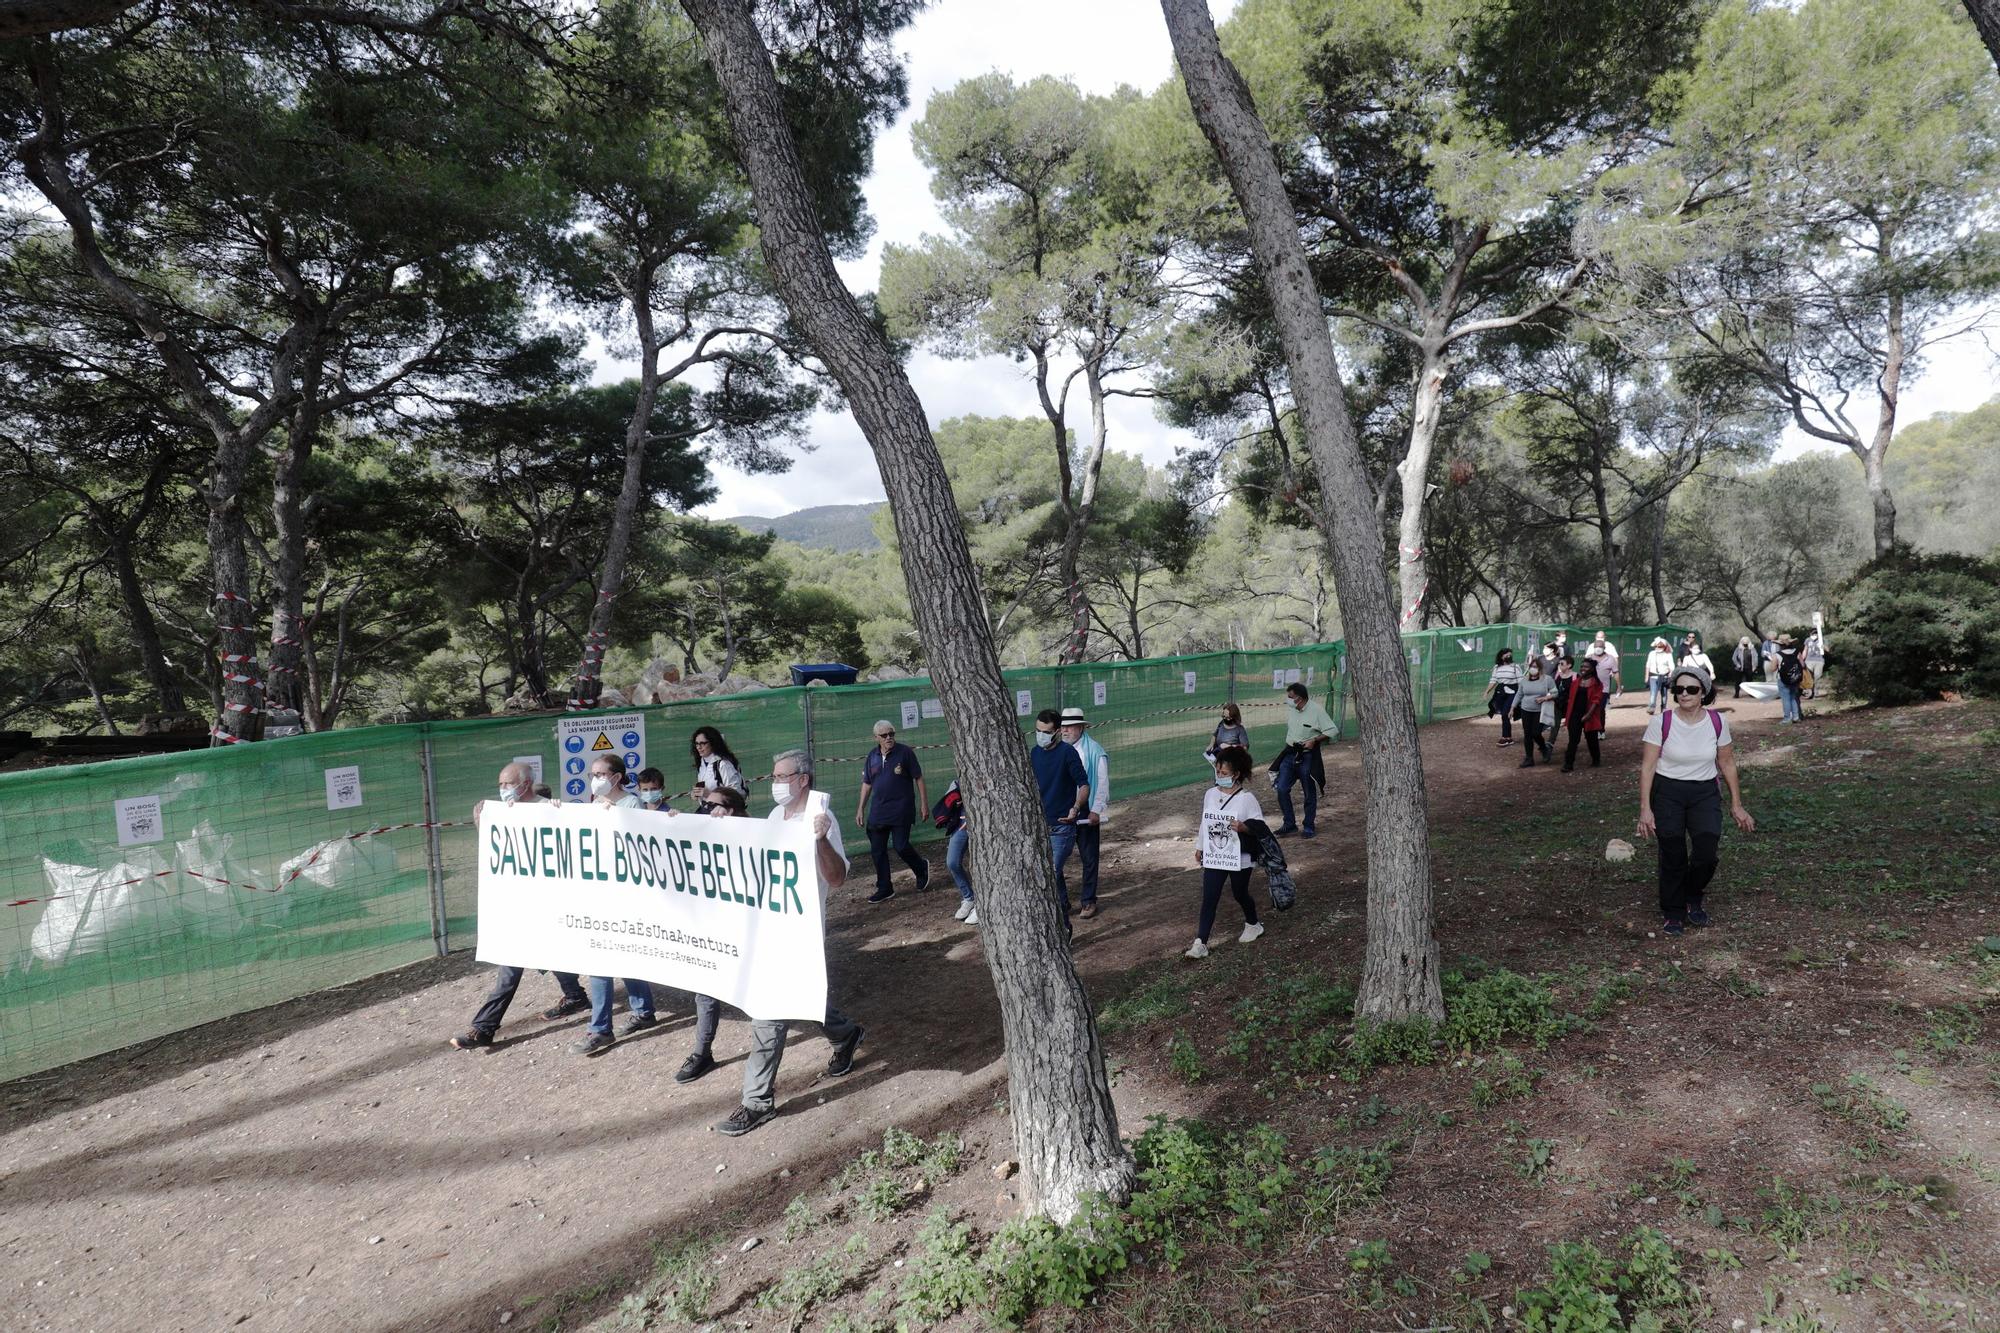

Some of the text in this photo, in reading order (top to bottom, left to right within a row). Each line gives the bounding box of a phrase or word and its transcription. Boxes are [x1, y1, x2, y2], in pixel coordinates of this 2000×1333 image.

[572, 719, 604, 727] OBLIGATORIO
[609, 723, 636, 731] SEGURIDAD
[1205, 859, 1238, 867] AVENTURA
[490, 824, 803, 915] SALVEM EL BOSC DE BELLVER
